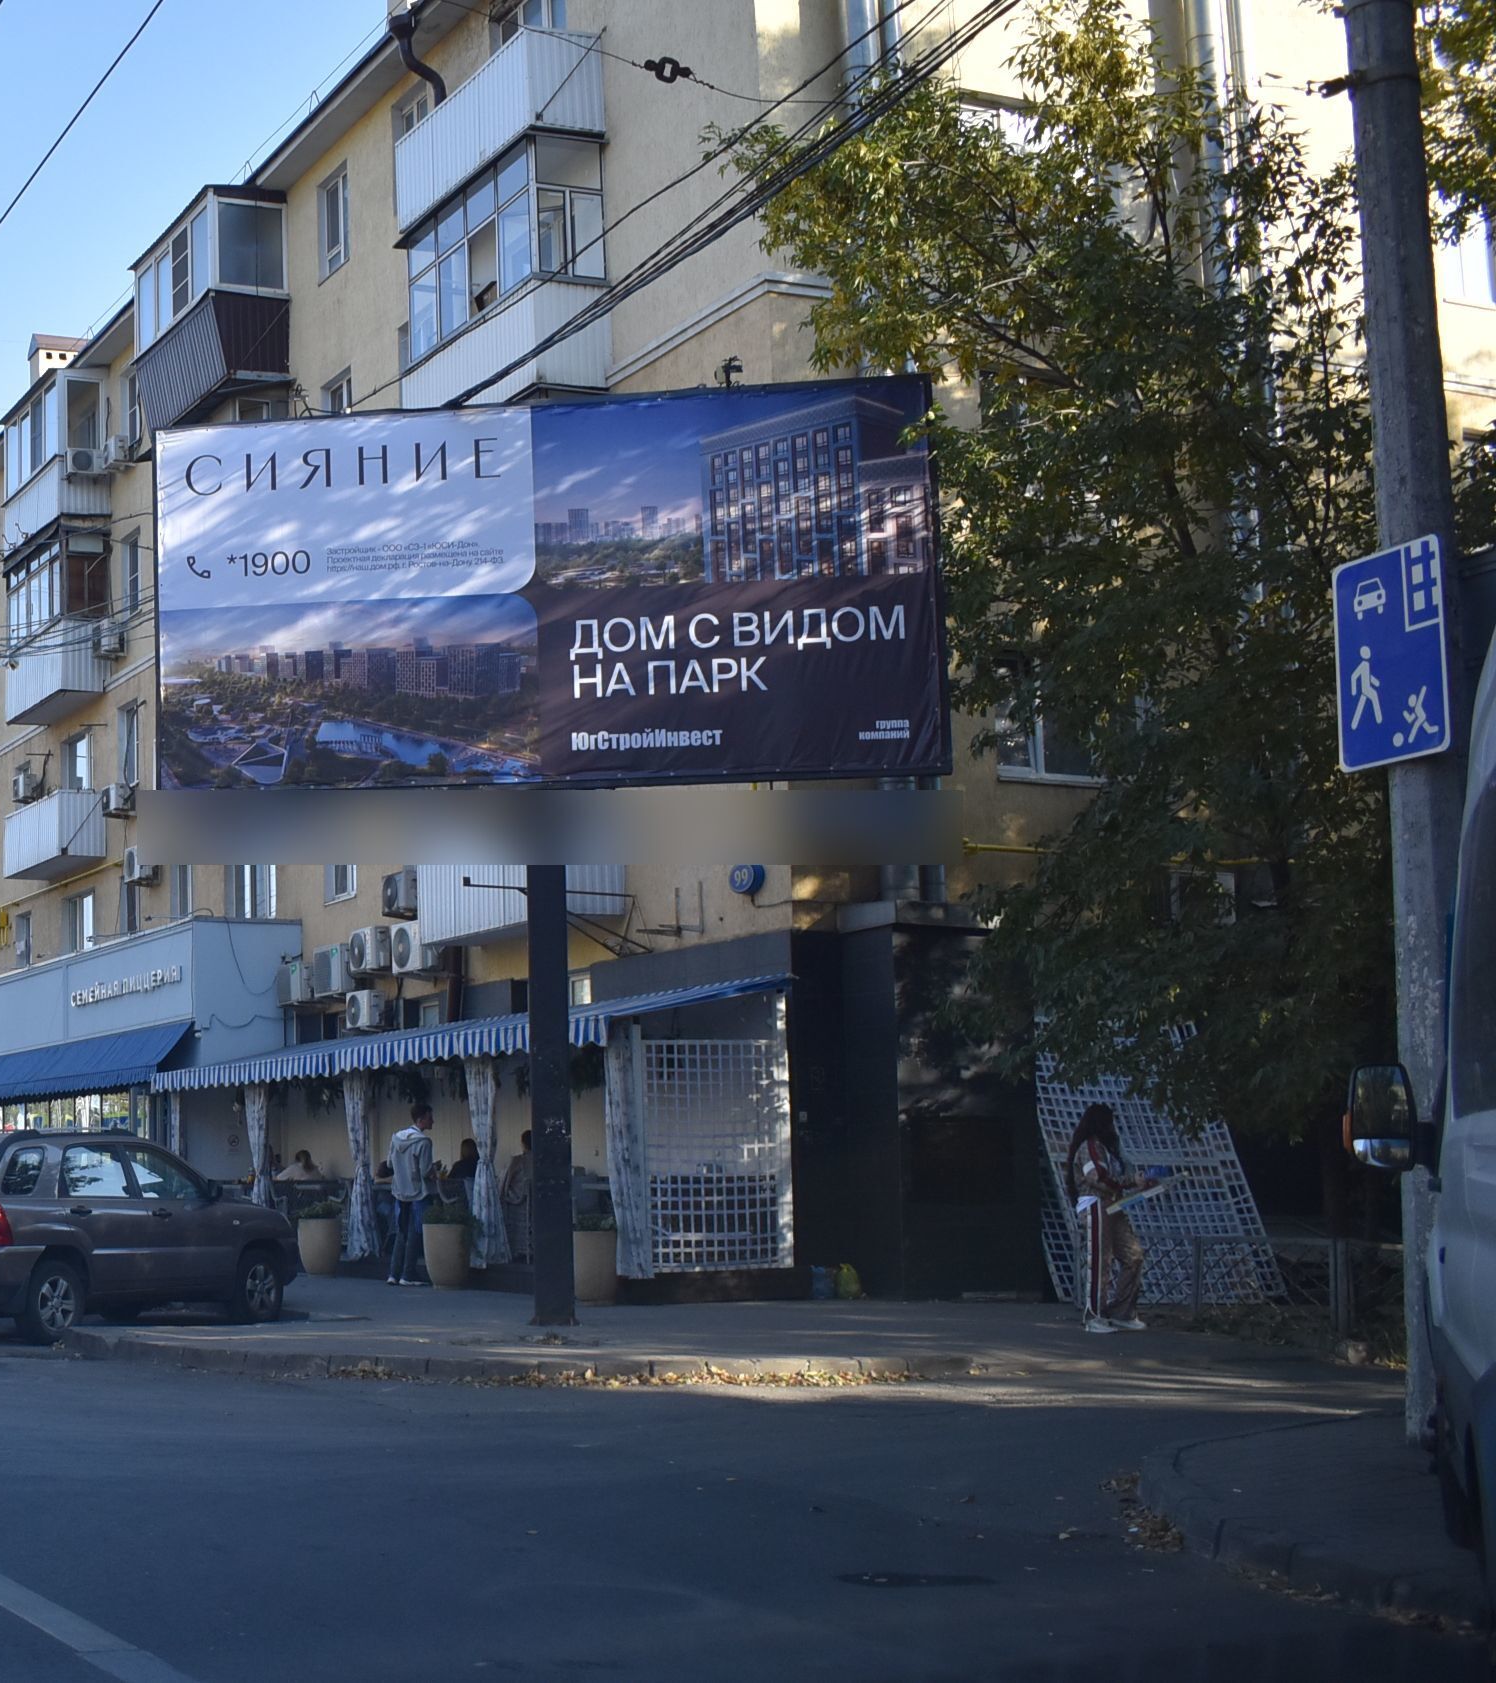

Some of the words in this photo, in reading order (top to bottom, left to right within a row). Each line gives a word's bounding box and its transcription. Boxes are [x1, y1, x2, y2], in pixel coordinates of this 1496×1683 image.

[185, 438, 501, 496] СИЯНИЕ
[327, 554, 371, 565] Проектная
[372, 551, 420, 562] декларация
[421, 550, 468, 561] размещена
[469, 549, 479, 557] на
[382, 543, 403, 552] ООО
[570, 615, 676, 660] ДОМ
[688, 613, 721, 649] С
[733, 605, 906, 650] ВИДОМ
[573, 663, 636, 699] НА
[648, 656, 768, 696] ПАРК
[858, 729, 910, 741] компаний
[875, 719, 910, 730] группа
[571, 728, 723, 751] ЮгСтройИнвест
[734, 868, 748, 888] 99
[70, 980, 120, 1007] СЕМЕЙНАЯ
[122, 965, 180, 994] ПИЦЦЕРИЯ
